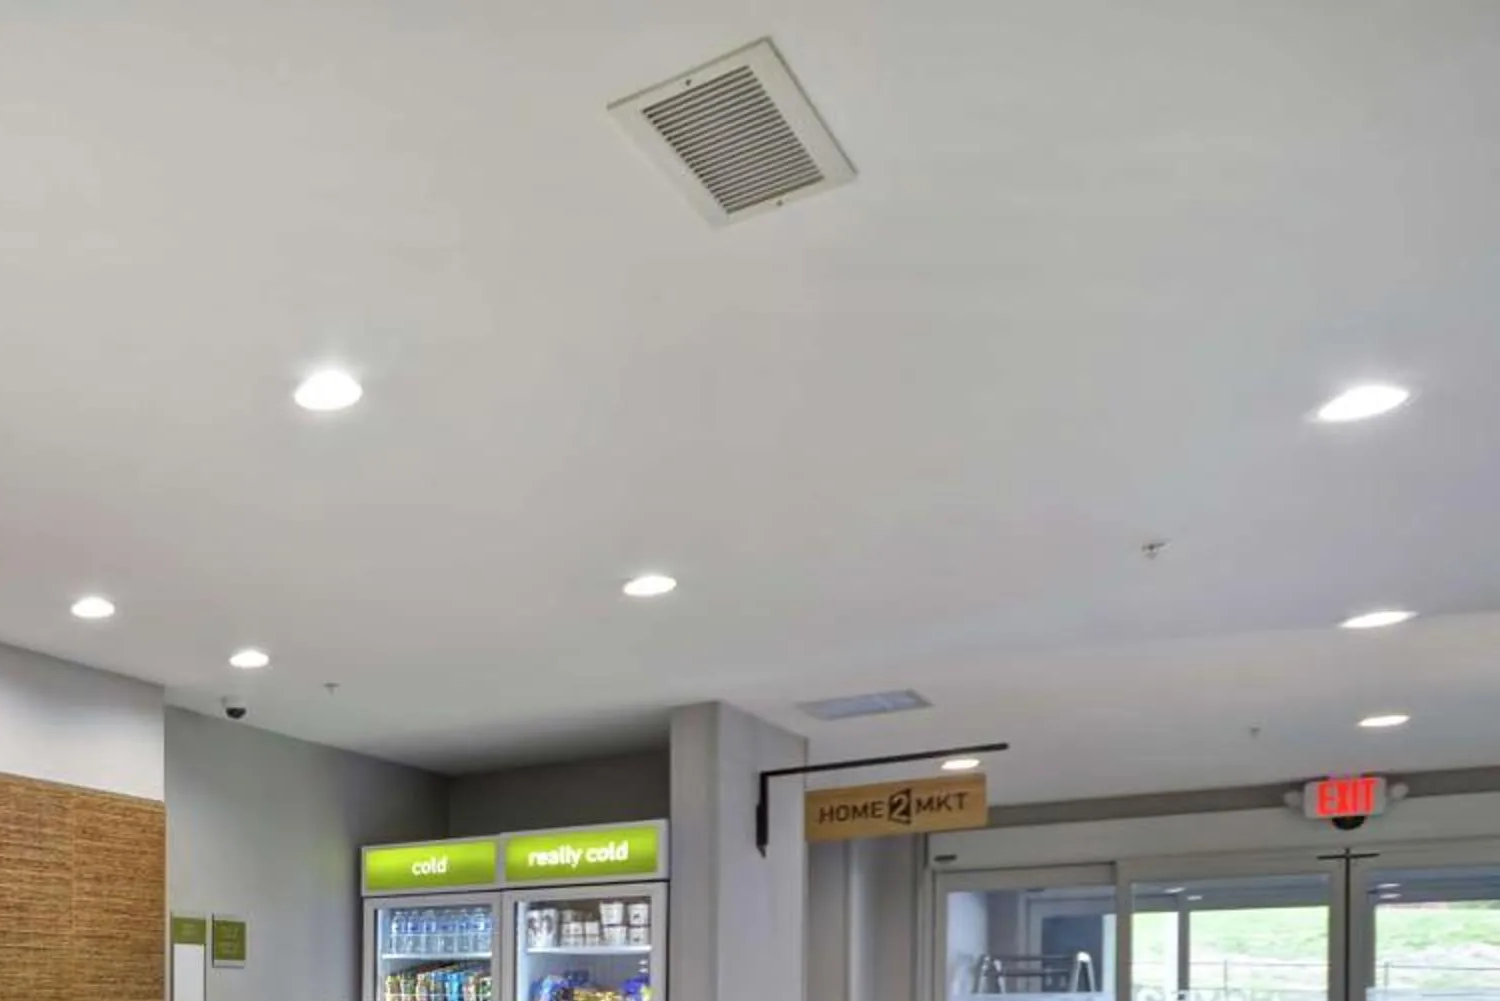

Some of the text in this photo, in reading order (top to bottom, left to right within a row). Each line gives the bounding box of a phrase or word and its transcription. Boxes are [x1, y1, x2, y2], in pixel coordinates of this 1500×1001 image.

[1316, 777, 1377, 816] EXIT
[411, 856, 448, 876] cold
[527, 841, 629, 868] really cold
